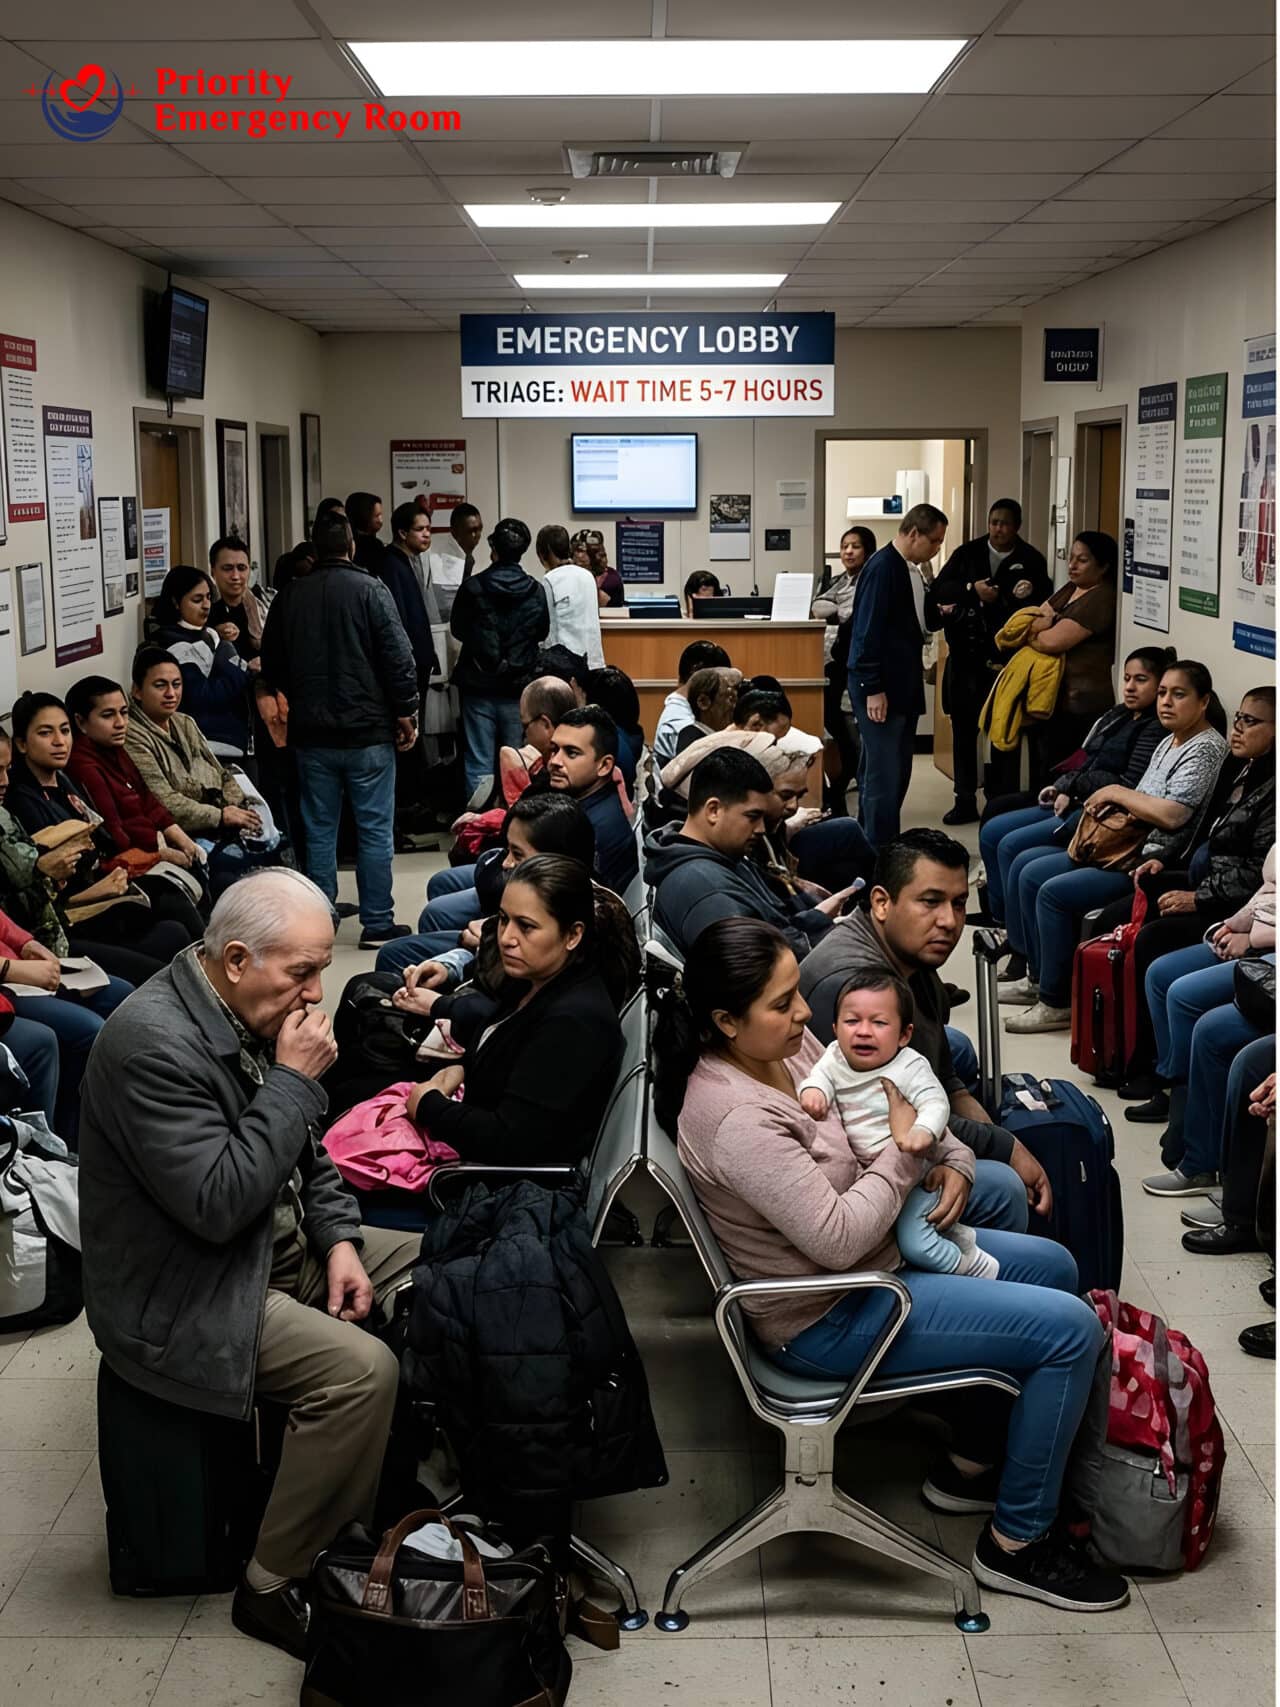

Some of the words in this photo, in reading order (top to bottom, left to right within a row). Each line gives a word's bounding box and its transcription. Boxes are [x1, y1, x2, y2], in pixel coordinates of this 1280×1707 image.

[496, 325, 689, 354] EMERGENCY
[698, 325, 800, 353] LOBBY
[471, 380, 564, 404] TRIAGE:
[570, 380, 629, 403] WAIT
[636, 379, 692, 402] TIME
[699, 379, 737, 402] 5-7
